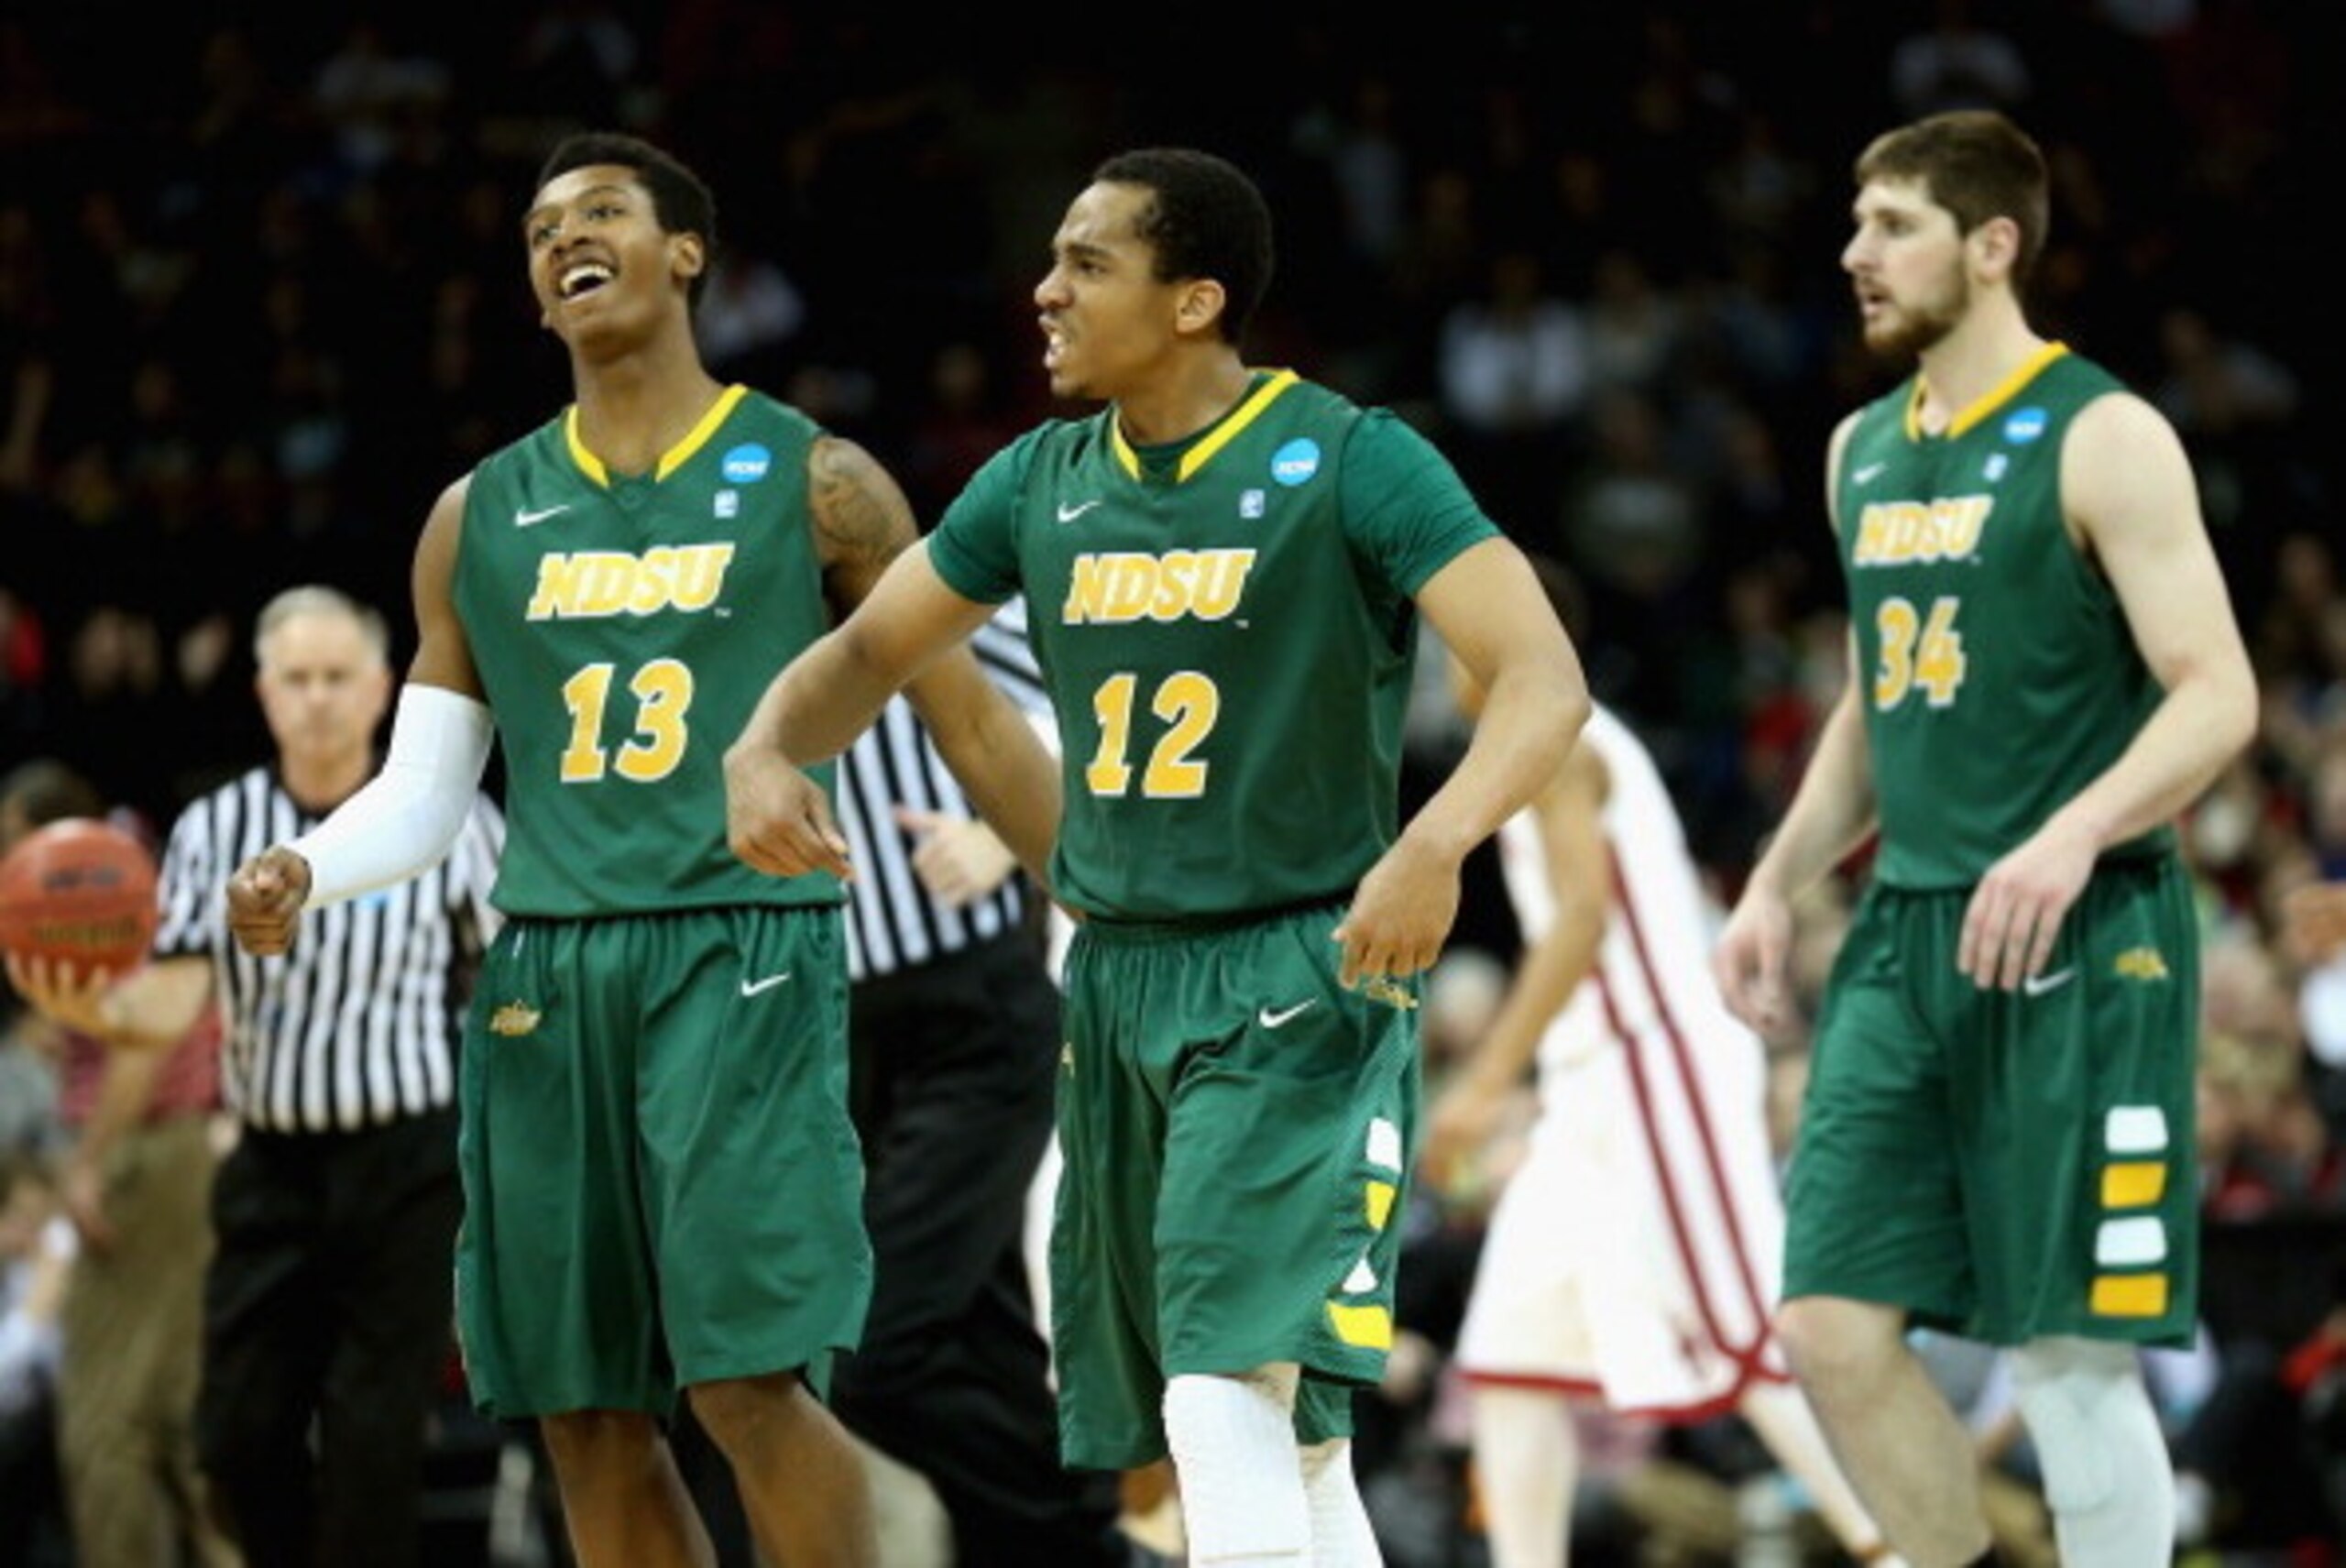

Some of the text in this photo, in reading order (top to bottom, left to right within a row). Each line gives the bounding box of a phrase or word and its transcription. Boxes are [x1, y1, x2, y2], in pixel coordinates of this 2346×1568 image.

[1853, 494, 1994, 567] NDSU
[526, 542, 735, 621] NDSU
[1062, 548, 1256, 624] NDSU
[1875, 597, 1967, 710] 34
[561, 658, 694, 783] 13
[1086, 671, 1220, 797] 12
